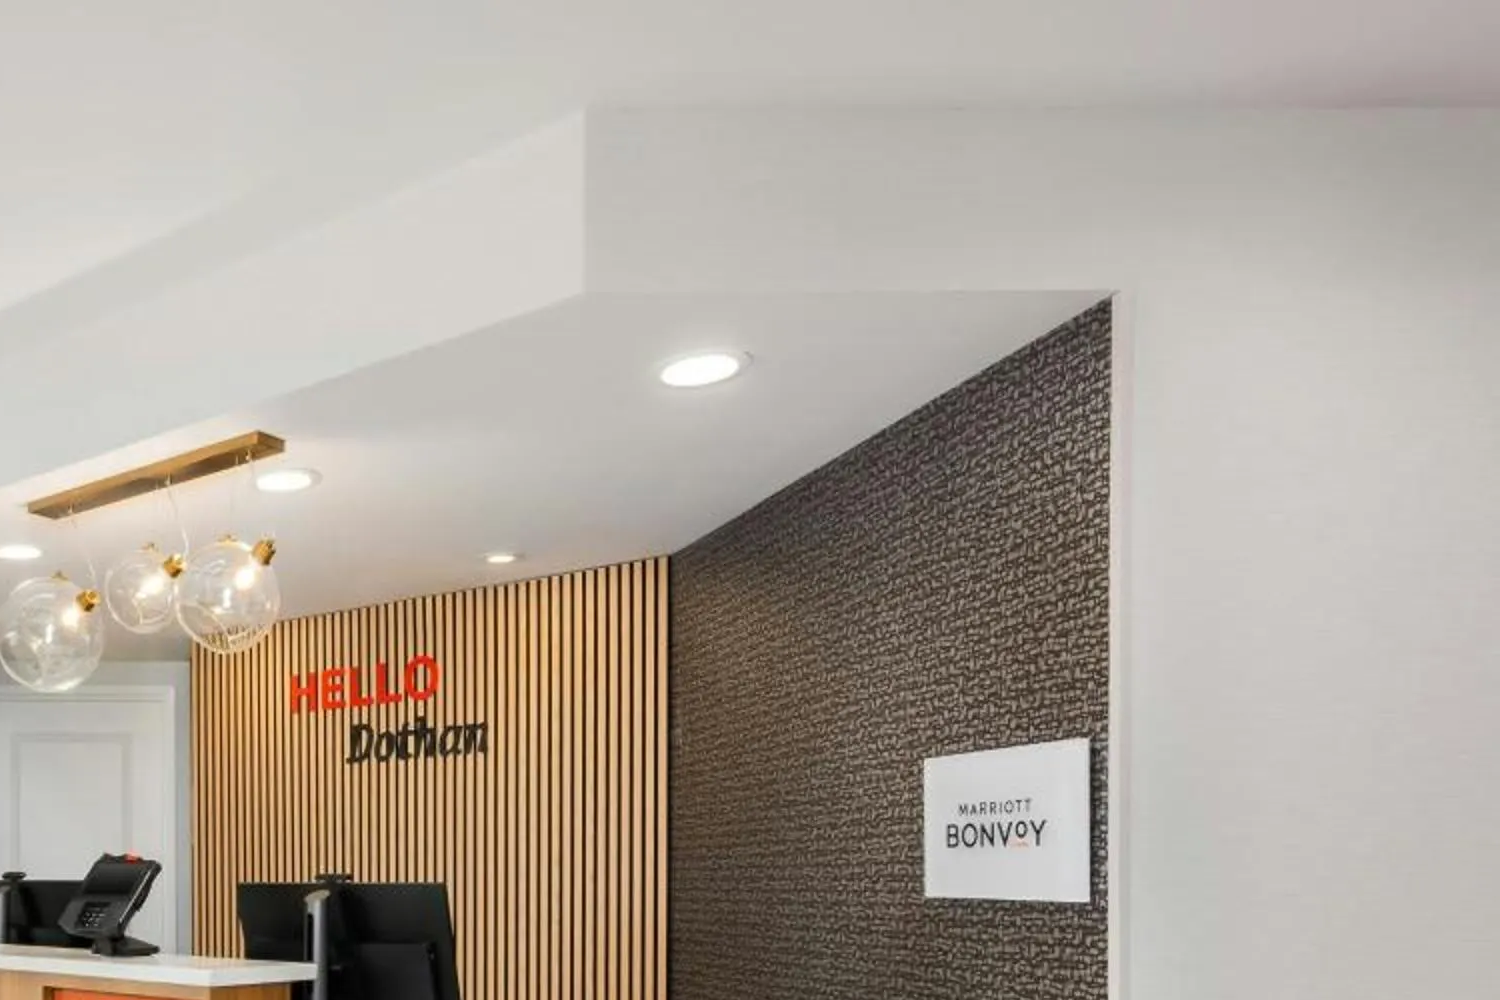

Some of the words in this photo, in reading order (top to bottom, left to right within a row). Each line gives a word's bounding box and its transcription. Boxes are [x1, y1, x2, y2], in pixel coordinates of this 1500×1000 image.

[289, 654, 442, 714] HELLO
[346, 715, 489, 764] Dothan
[959, 799, 1032, 816] MARRIOTT
[947, 820, 1046, 848] BONVOY
